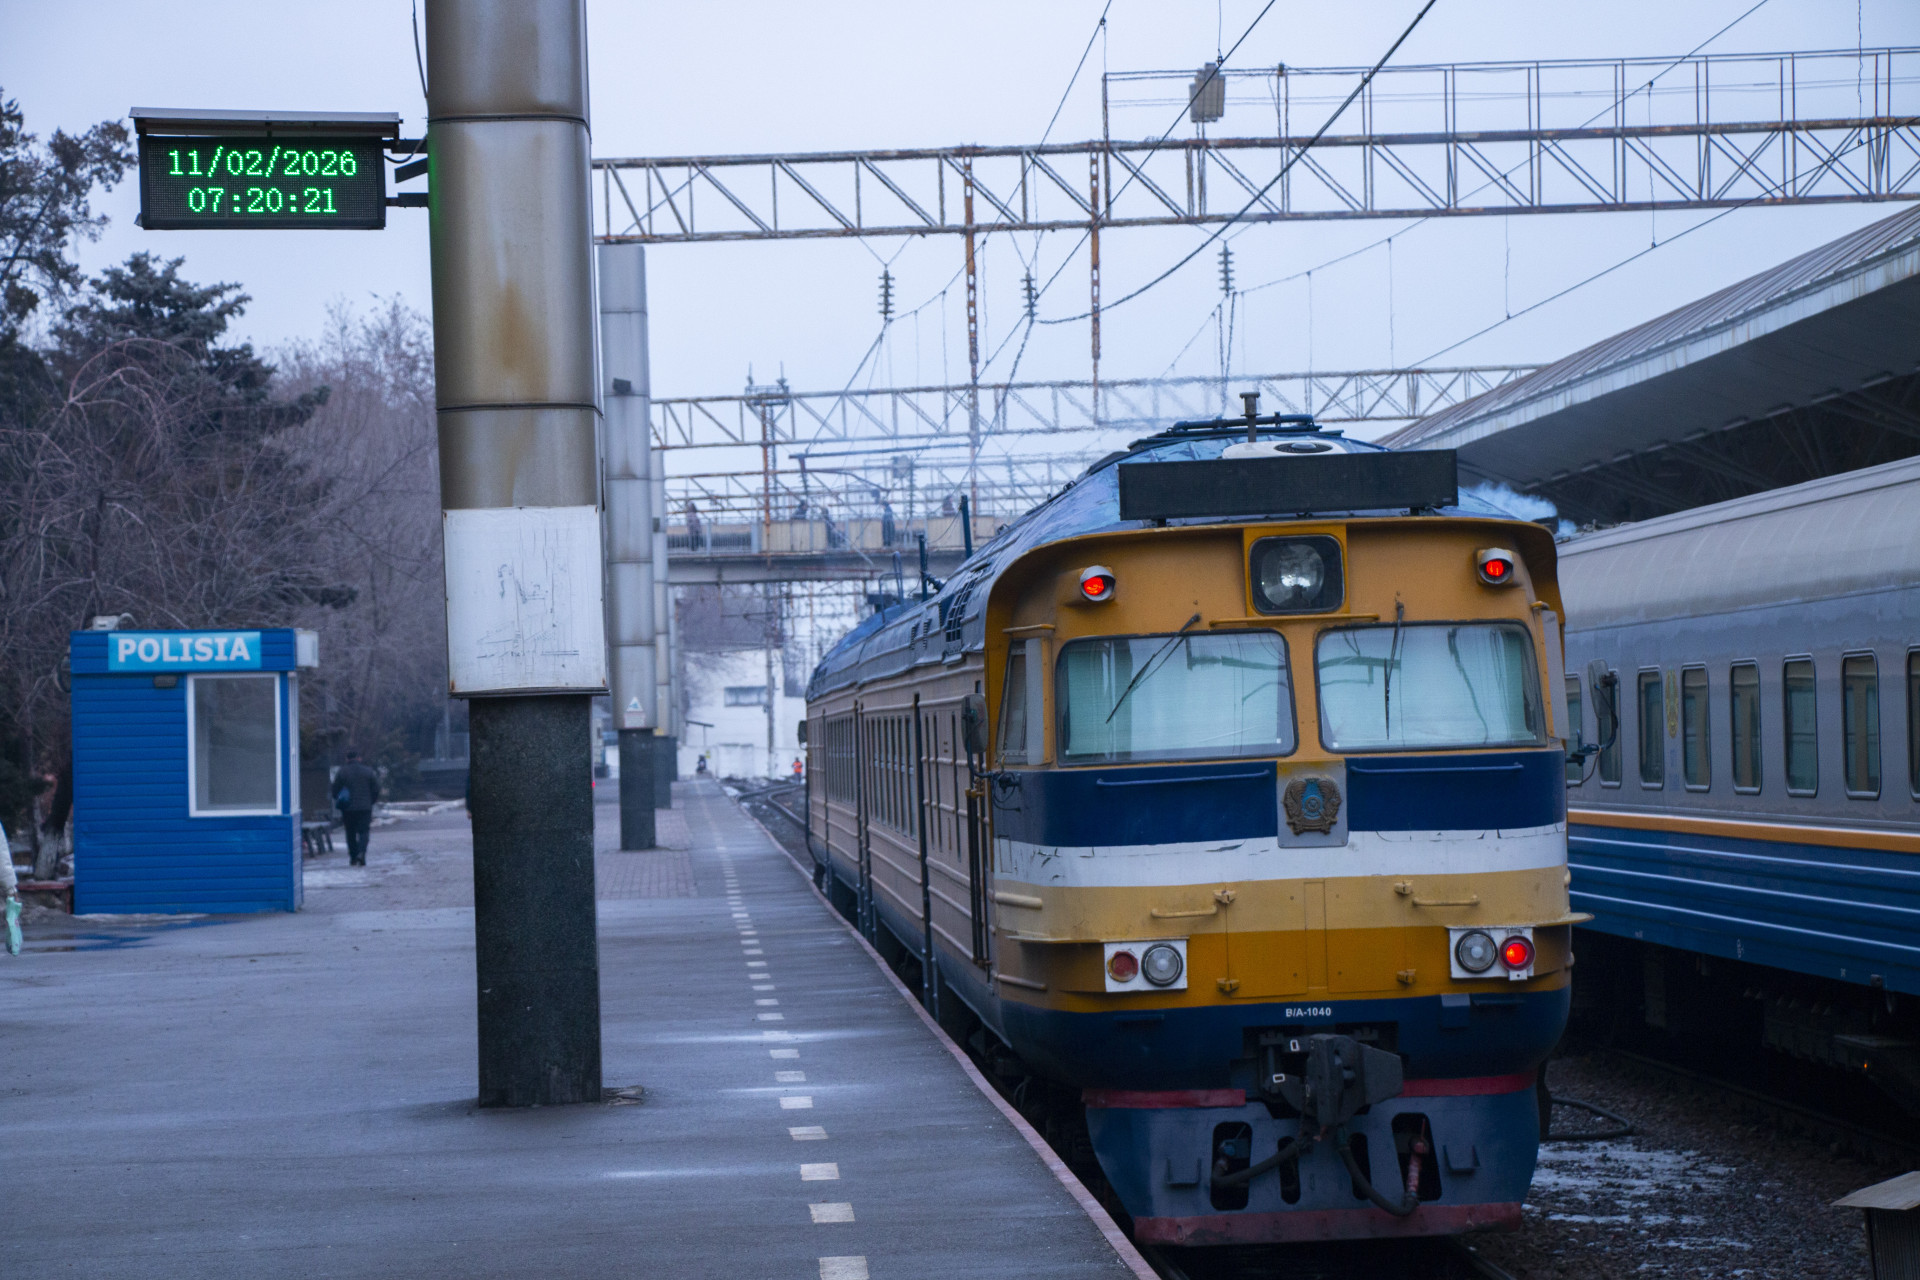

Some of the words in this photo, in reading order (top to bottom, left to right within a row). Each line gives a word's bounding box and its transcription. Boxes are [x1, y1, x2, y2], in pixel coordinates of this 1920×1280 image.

[168, 145, 357, 178] 11/02/2026
[187, 186, 338, 213] 07:20:21
[117, 637, 251, 663] POLISIA
[1285, 1007, 1332, 1018] B/A-1040
